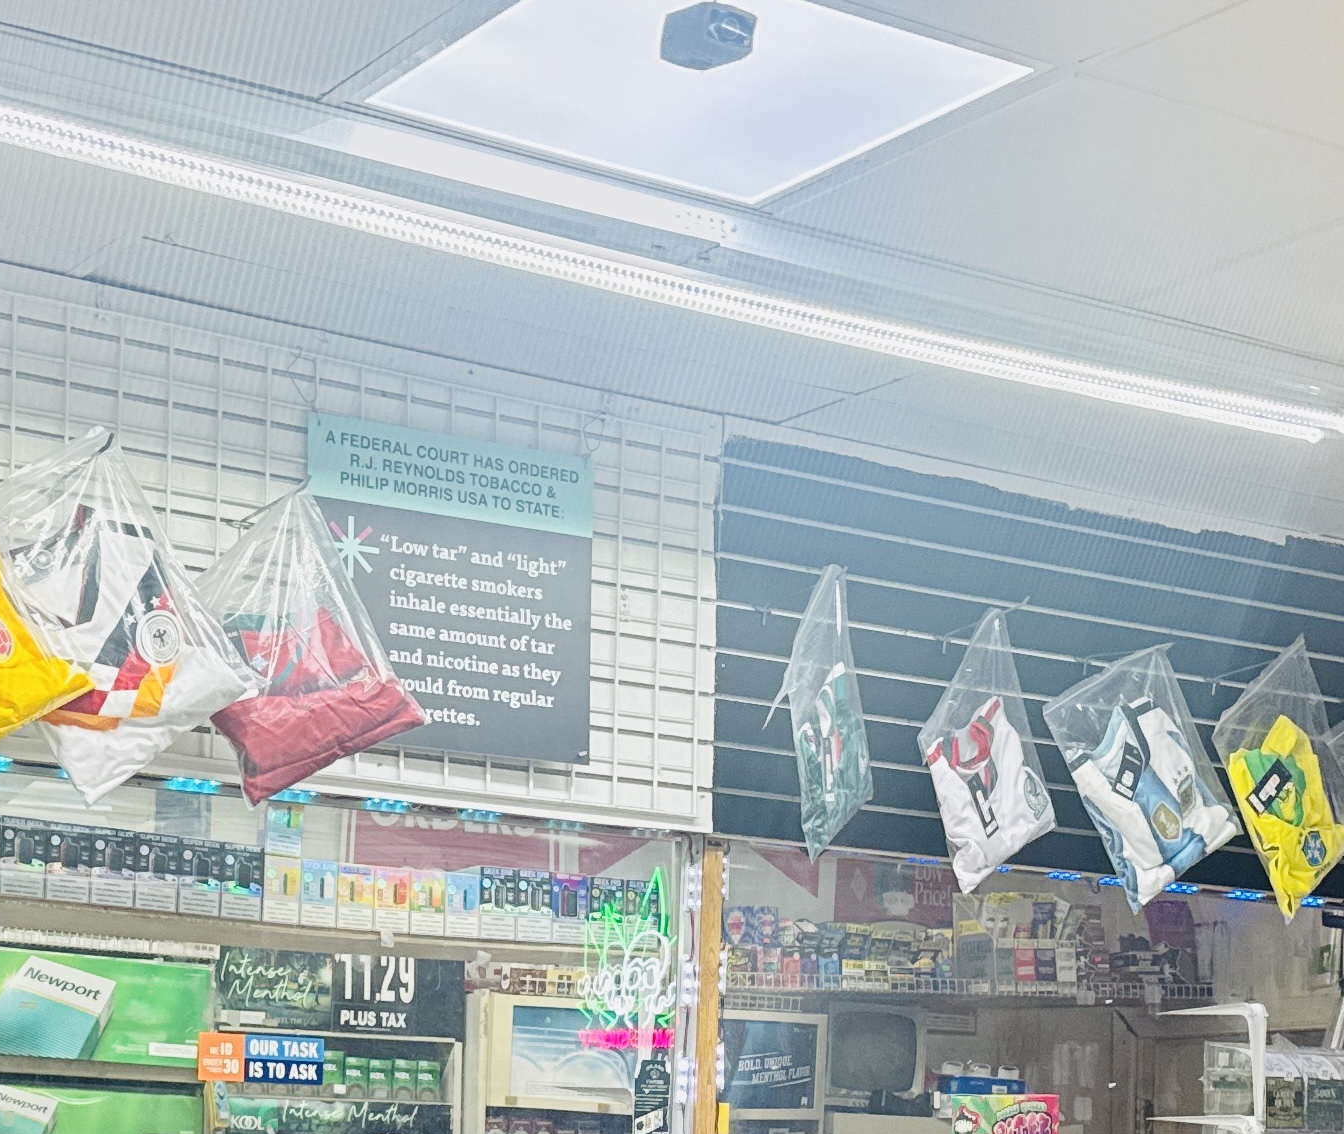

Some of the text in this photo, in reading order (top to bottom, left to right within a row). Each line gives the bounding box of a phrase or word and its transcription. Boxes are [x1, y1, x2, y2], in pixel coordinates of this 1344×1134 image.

[325, 431, 579, 484] A FEDERAL COURT HAS ORDERED
[350, 454, 556, 499] R.J. REYNOLDS TOBACCO &
[340, 472, 564, 519] PHILIP MORRIS USA TO STATE:
[380, 534, 566, 577] “Low tar” and “light”
[390, 564, 543, 600] cigarette smokers
[390, 590, 572, 630] inhale essentially the
[389, 622, 555, 655] same amount of tar
[389, 649, 561, 686] and nicotine as they
[447, 680, 489, 700] from
[493, 689, 555, 709] regular
[220, 952, 291, 981] Intense
[24, 966, 101, 1001] Newport
[228, 976, 311, 1007] Menthol
[340, 1010, 406, 1028] PLUS TAX
[250, 1039, 319, 1058] OUR TASK
[249, 1061, 318, 1081] IS TO ASK
[231, 1116, 264, 1130] KOOL
[282, 1100, 419, 1128] Intense Menthol
